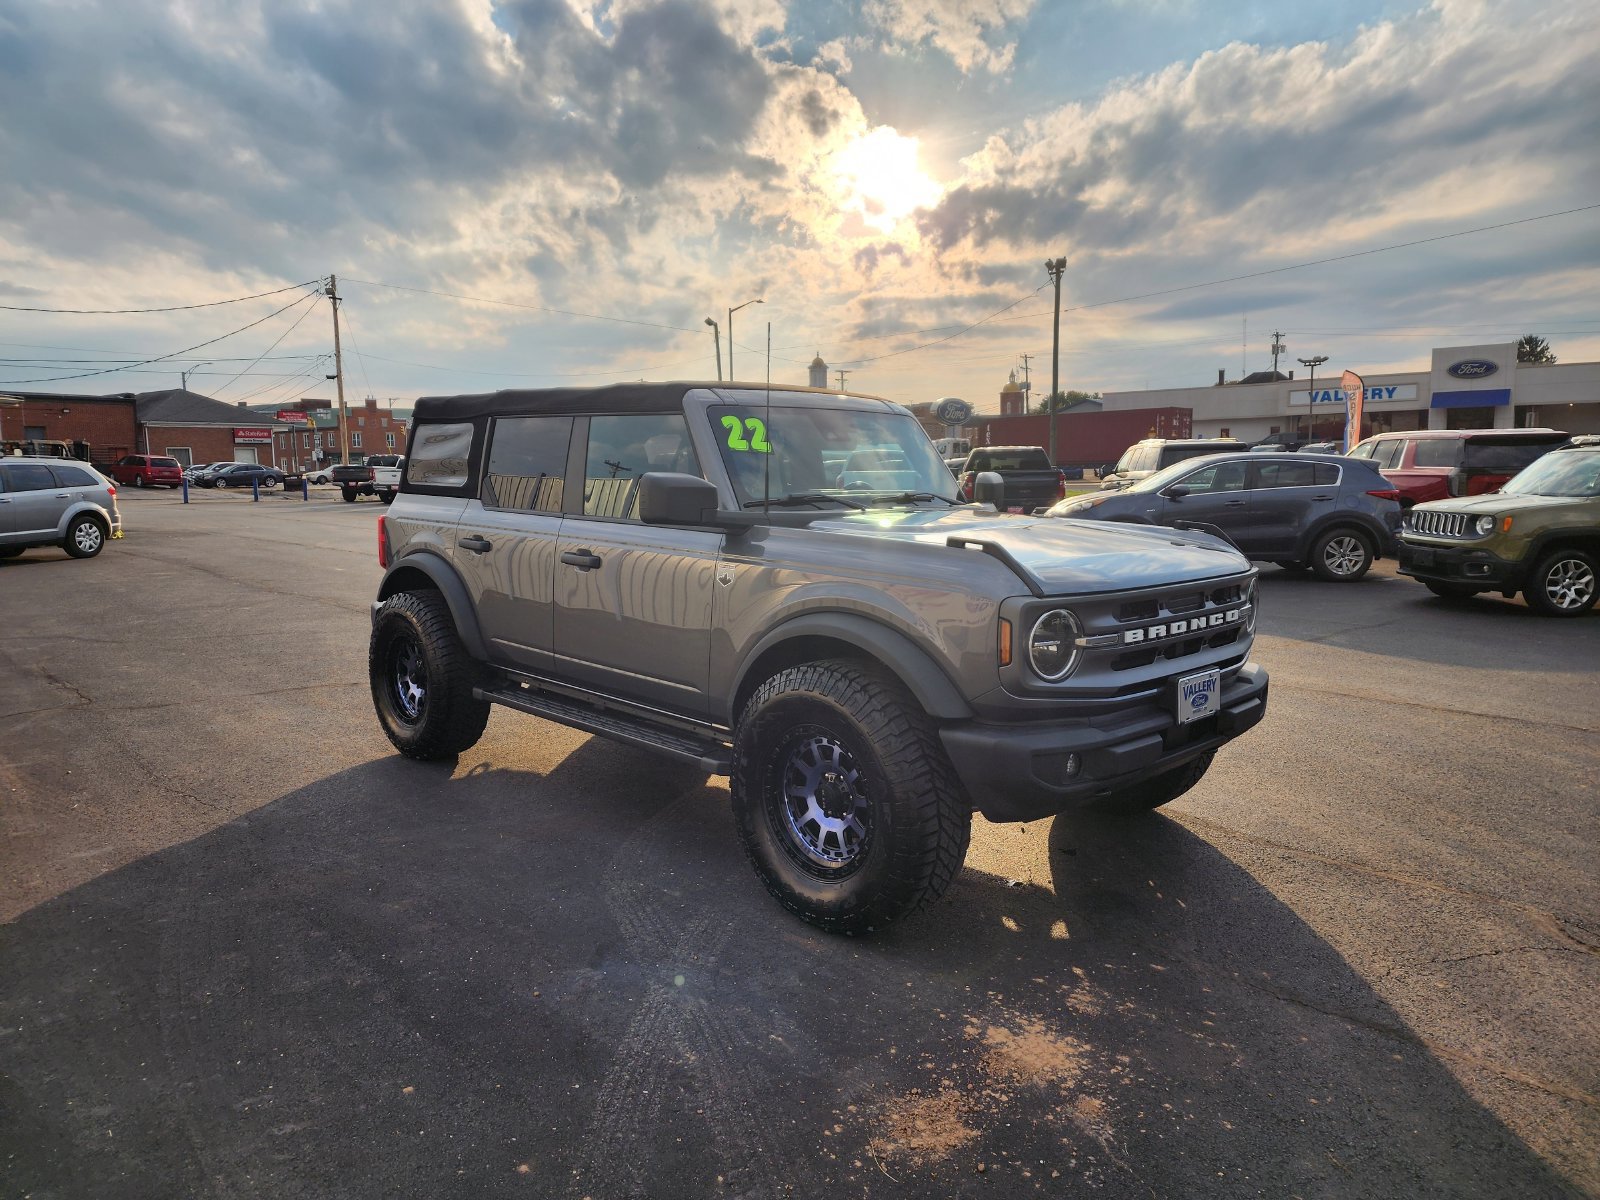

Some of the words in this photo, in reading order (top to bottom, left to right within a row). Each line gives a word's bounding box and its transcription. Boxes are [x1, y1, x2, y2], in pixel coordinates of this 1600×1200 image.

[1457, 363, 1487, 374] Ford
[720, 415, 772, 453] 22
[1124, 609, 1239, 643] BRONCO
[1182, 677, 1217, 701] VALLERY
